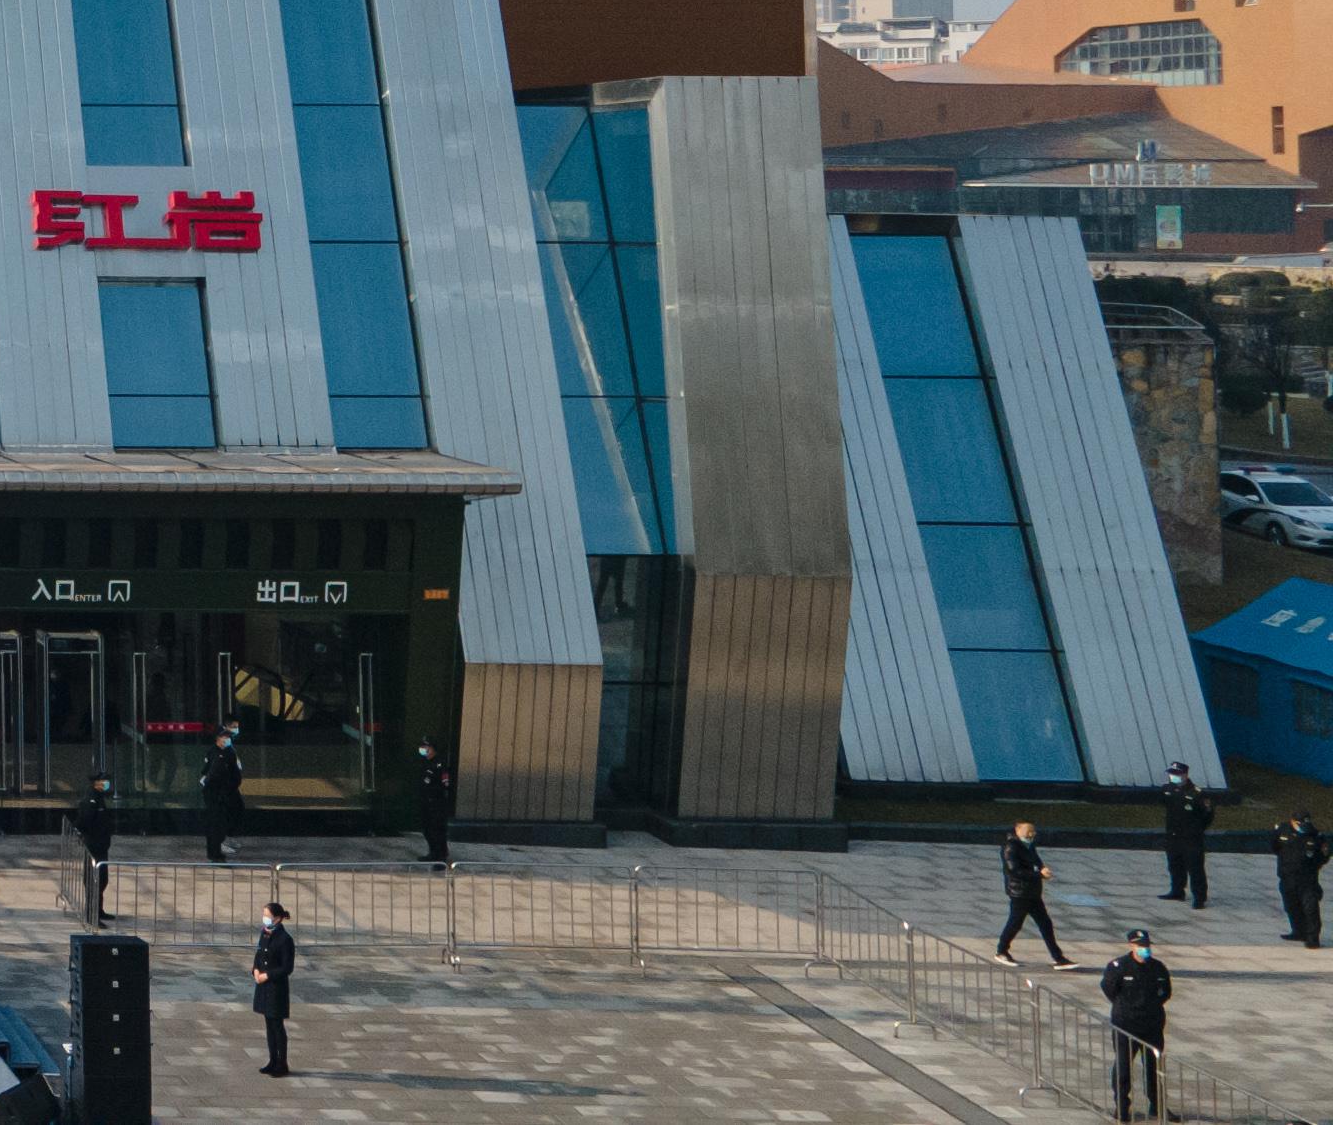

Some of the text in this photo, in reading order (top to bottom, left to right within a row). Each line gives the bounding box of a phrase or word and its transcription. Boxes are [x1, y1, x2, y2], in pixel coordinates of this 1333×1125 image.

[30, 190, 263, 251] 红岩
[31, 578, 102, 603] 入口 ENTER
[256, 579, 300, 603] 出口
